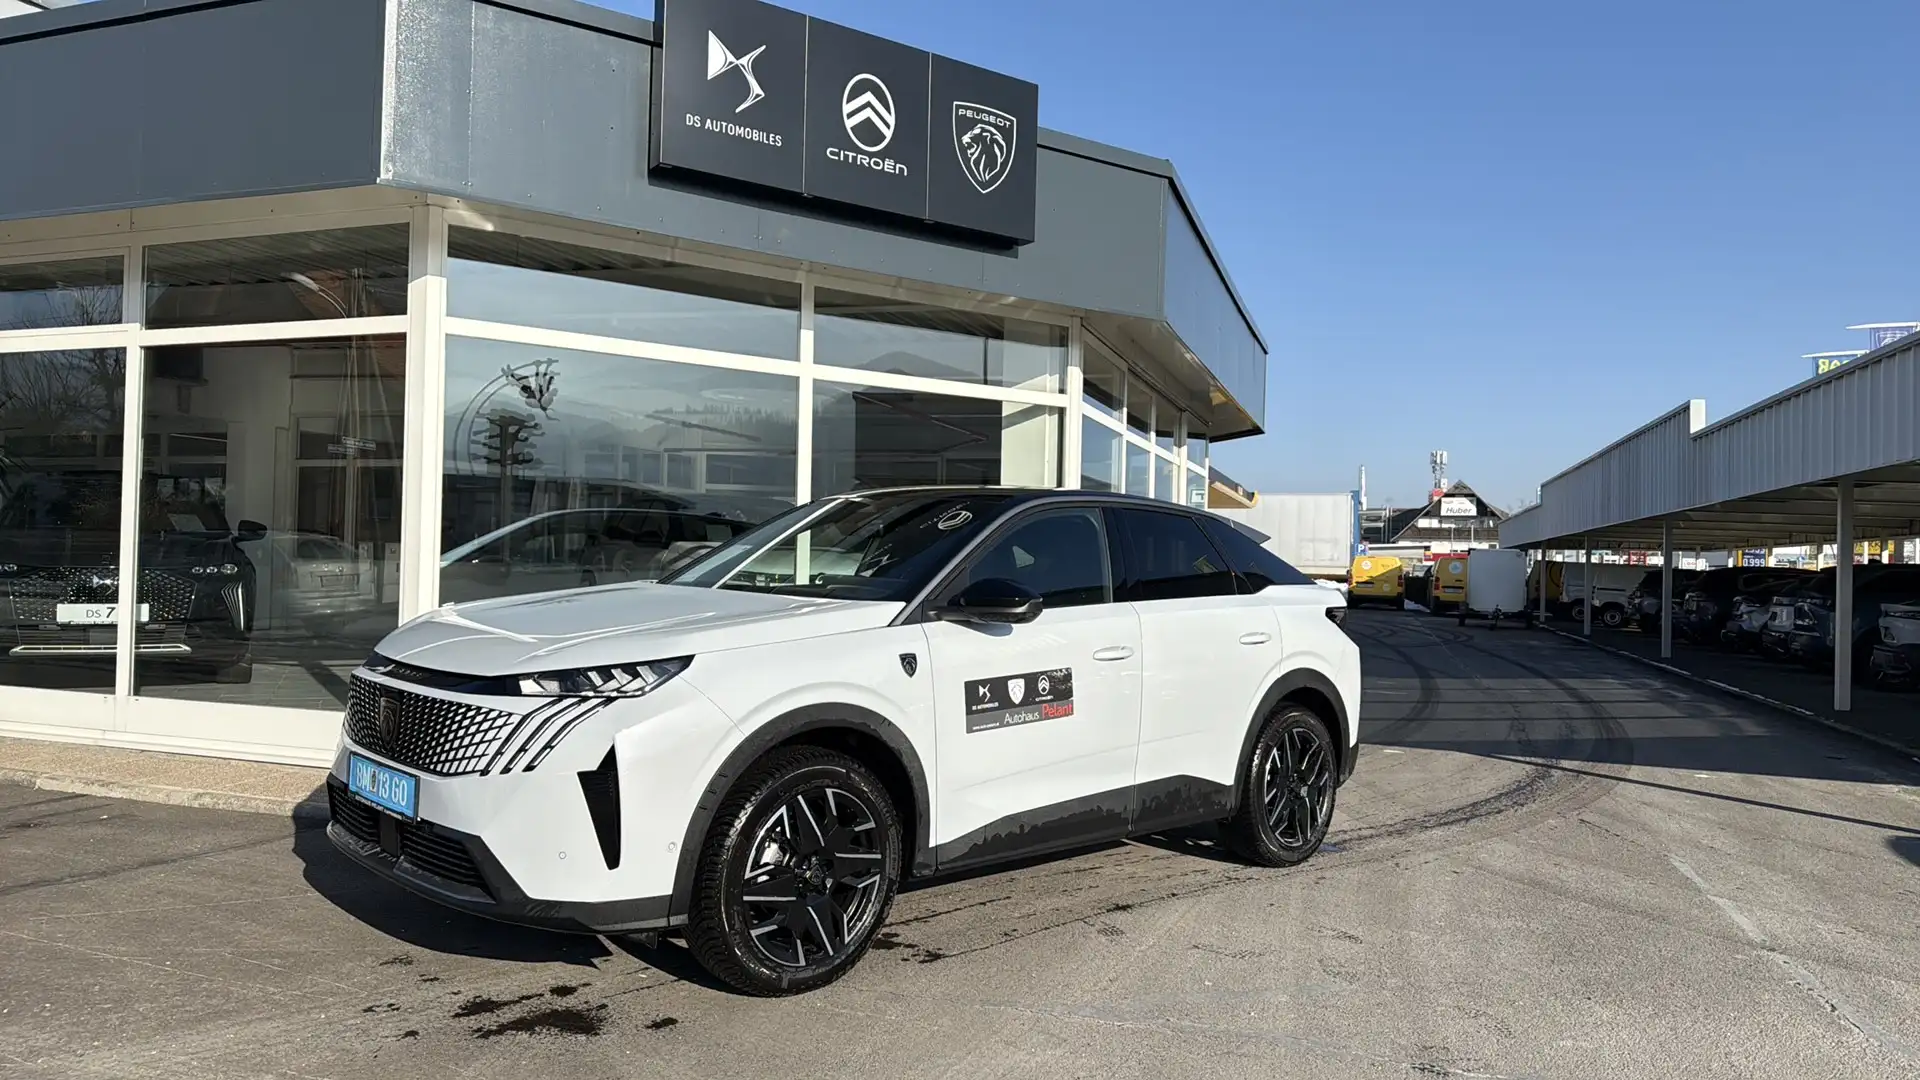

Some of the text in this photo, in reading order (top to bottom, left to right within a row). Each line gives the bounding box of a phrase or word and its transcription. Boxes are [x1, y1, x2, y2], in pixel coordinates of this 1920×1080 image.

[958, 108, 1012, 129] PEUGEOT
[685, 113, 783, 147] DS AUTOMOBILES
[1445, 506, 1473, 514] Huber
[1358, 543, 1366, 553] P
[86, 606, 117, 619] DS 7
[1003, 703, 1073, 725] Autohaus Pelant
[356, 761, 371, 791] BM
[378, 770, 390, 800] 13
